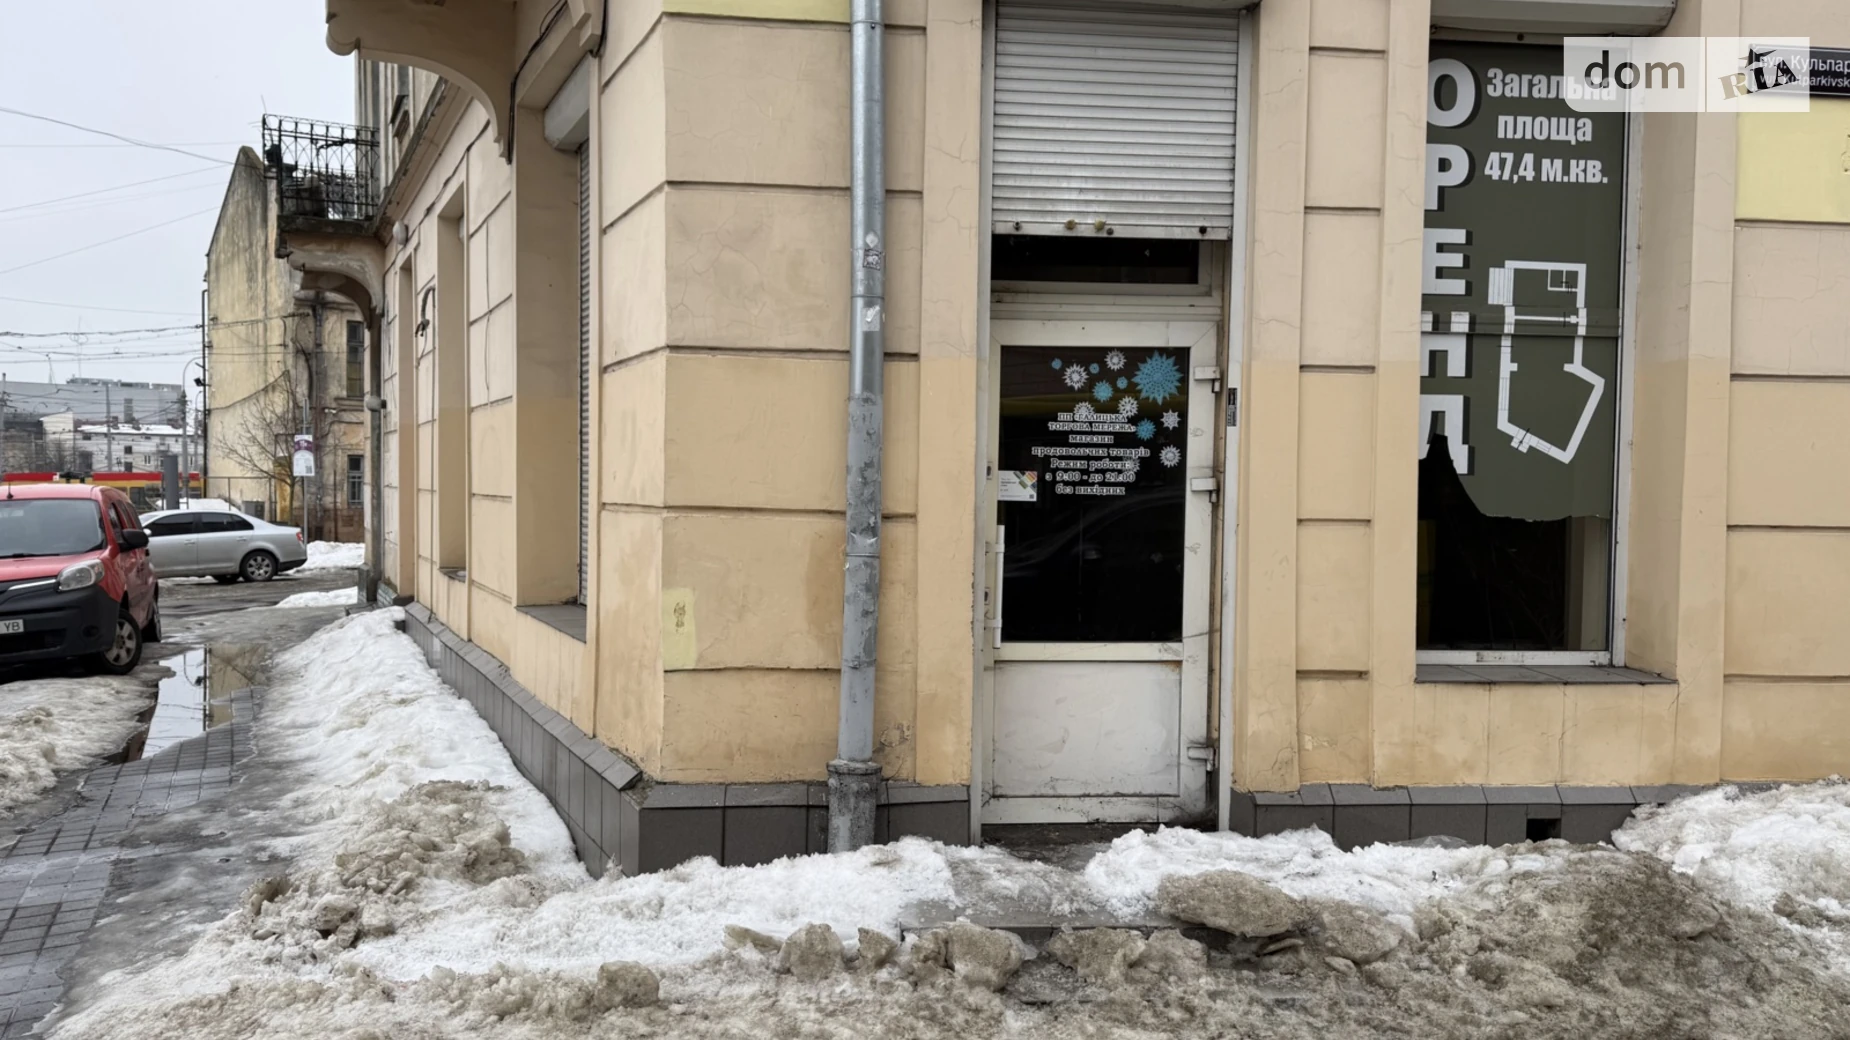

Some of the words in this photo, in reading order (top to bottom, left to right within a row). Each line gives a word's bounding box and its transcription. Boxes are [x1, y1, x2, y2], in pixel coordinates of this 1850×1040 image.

[1486, 68, 1617, 101] Загальна
[1497, 115, 1593, 145] площа
[1484, 151, 1535, 184] 47,4
[1540, 158, 1609, 183] м.кв.
[1031, 446, 1108, 457] продовольчих
[1109, 446, 1150, 459] товарів
[1050, 458, 1088, 468] Режим
[1089, 474, 1104, 482] до
[1055, 483, 1074, 494] без
[1075, 484, 1126, 495] вихідних
